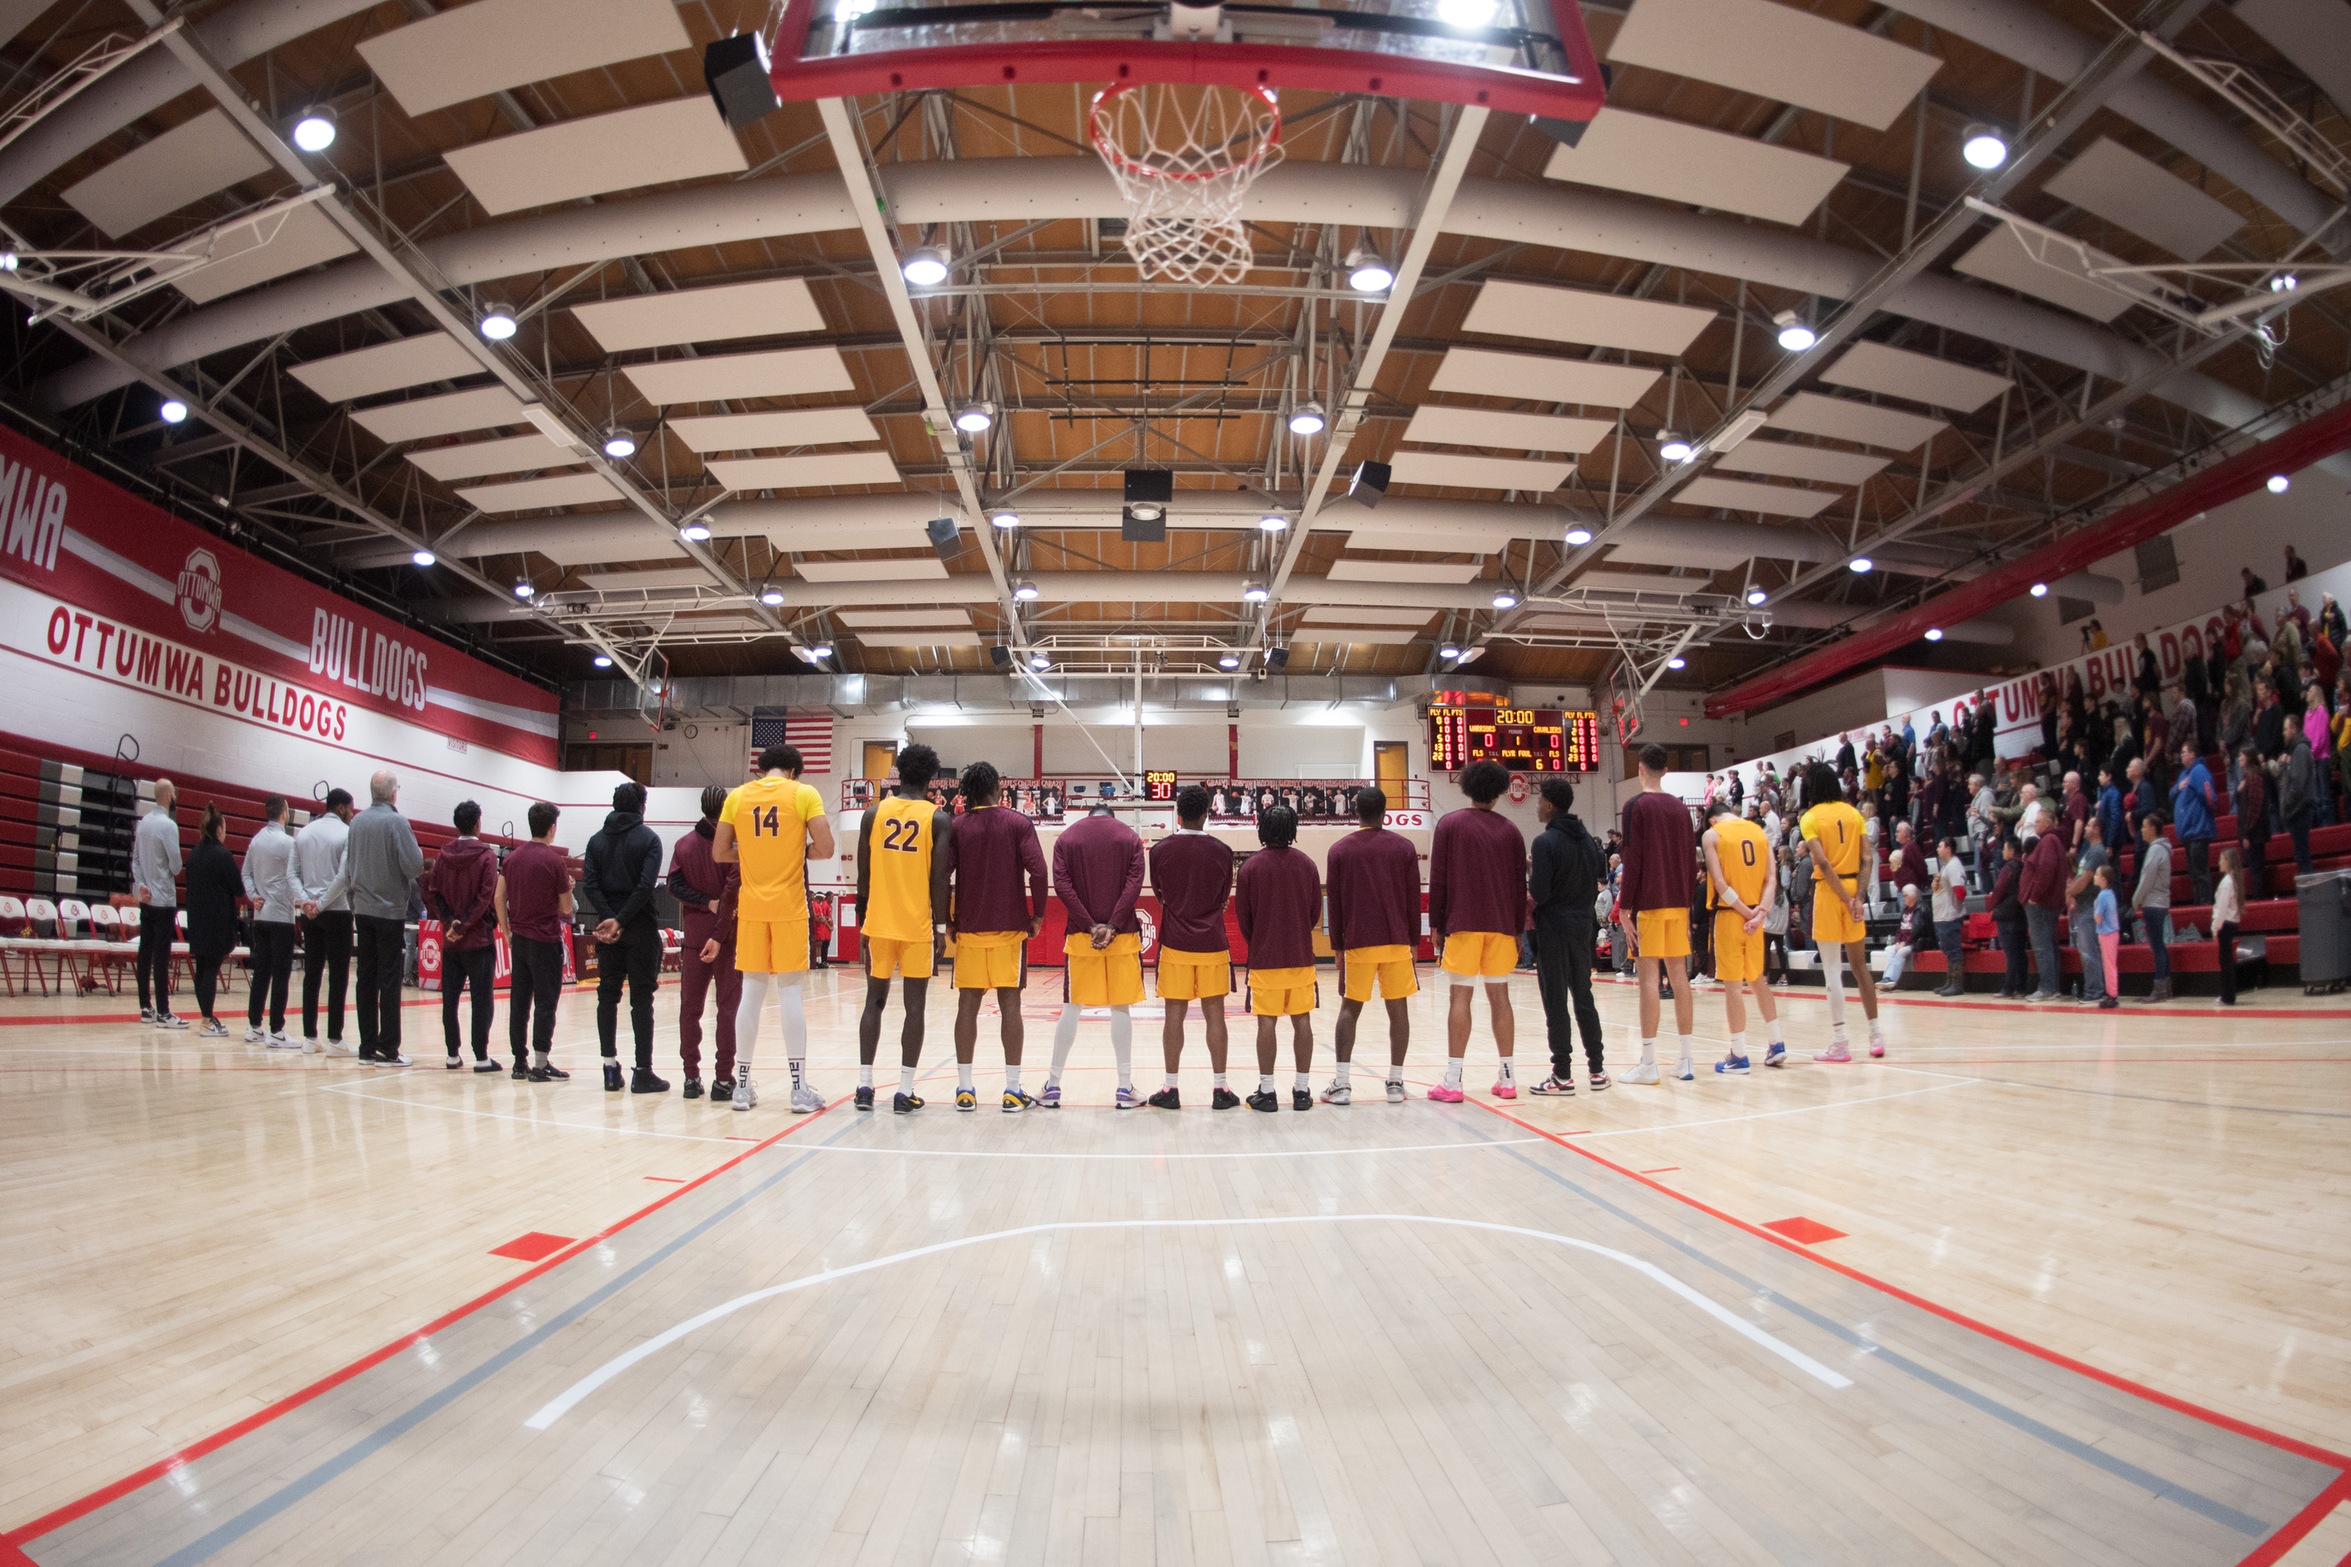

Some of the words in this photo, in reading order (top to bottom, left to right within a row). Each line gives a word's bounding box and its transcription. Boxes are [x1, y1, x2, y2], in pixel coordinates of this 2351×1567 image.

[177, 571, 223, 613] OTTUMWA
[308, 606, 428, 711] BULLDOGS
[47, 606, 204, 702] OTTUMWA
[214, 664, 348, 743] BULLDOGS
[1496, 710, 1534, 724] 20:00
[1571, 728, 1577, 736] 2
[1484, 734, 1493, 747] 0
[1515, 736, 1520, 745] 1
[1550, 735, 1559, 748] 0
[1432, 752, 1444, 761] 22
[1445, 752, 1451, 760] 0
[1458, 752, 1464, 760] 0
[1568, 754, 1578, 762] 23
[1580, 754, 1586, 762] 0
[1592, 754, 1598, 762] 0
[1446, 762, 1452, 770] 0
[1536, 759, 1543, 770] 6
[1553, 759, 1559, 770] 0
[1147, 772, 1175, 783] 20:00
[1151, 783, 1172, 800] 30
[1504, 782, 1530, 796] TTUMWA
[752, 805, 780, 837] 14
[883, 818, 920, 853] 22
[1837, 819, 1845, 844] 1
[1741, 840, 1756, 866] 0
[420, 948, 440, 961] OTTUMWA
